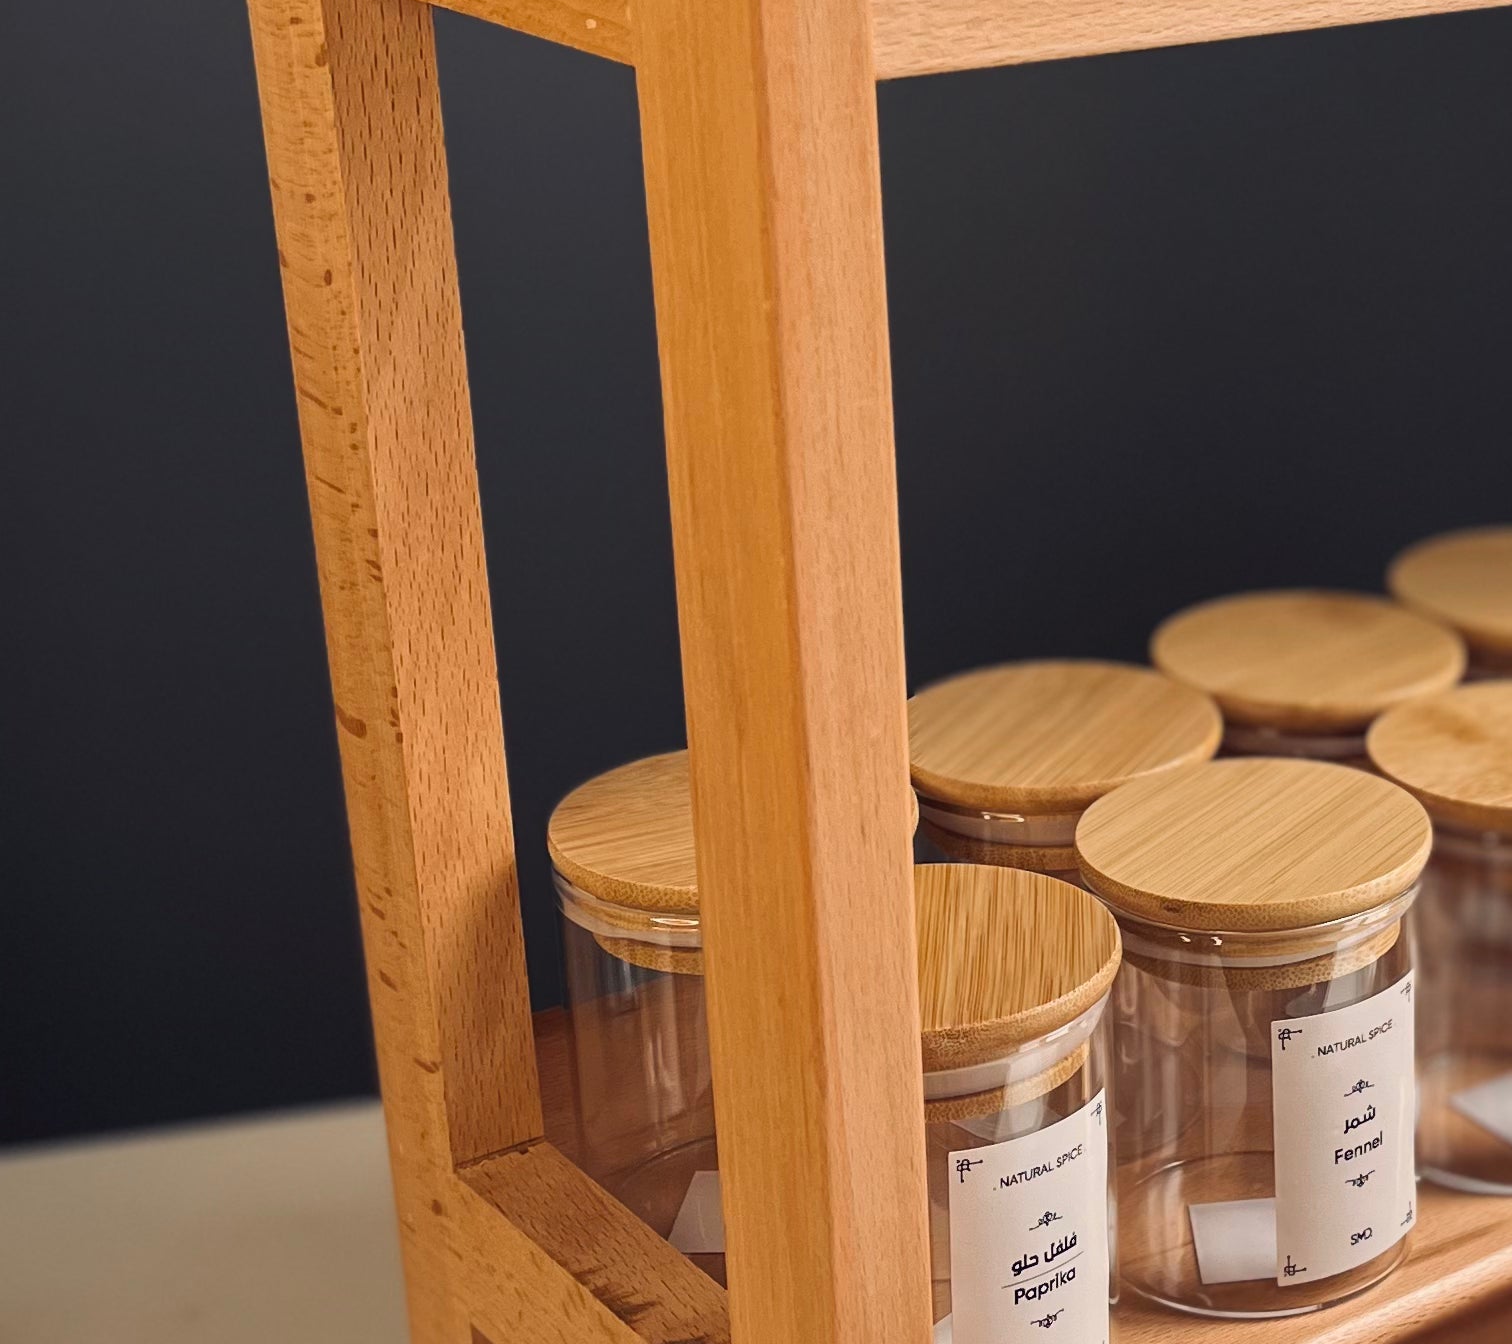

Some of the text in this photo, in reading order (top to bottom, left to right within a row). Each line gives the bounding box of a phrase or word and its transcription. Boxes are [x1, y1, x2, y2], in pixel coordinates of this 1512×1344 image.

[1318, 1034, 1367, 1057] NATURAL
[1343, 1104, 1376, 1134] شمر
[1334, 1130, 1383, 1165] Fennel
[1000, 1161, 1054, 1188] NATURAL
[1011, 1231, 1077, 1277] فلفل حلو
[1014, 1267, 1076, 1305] Paprika
